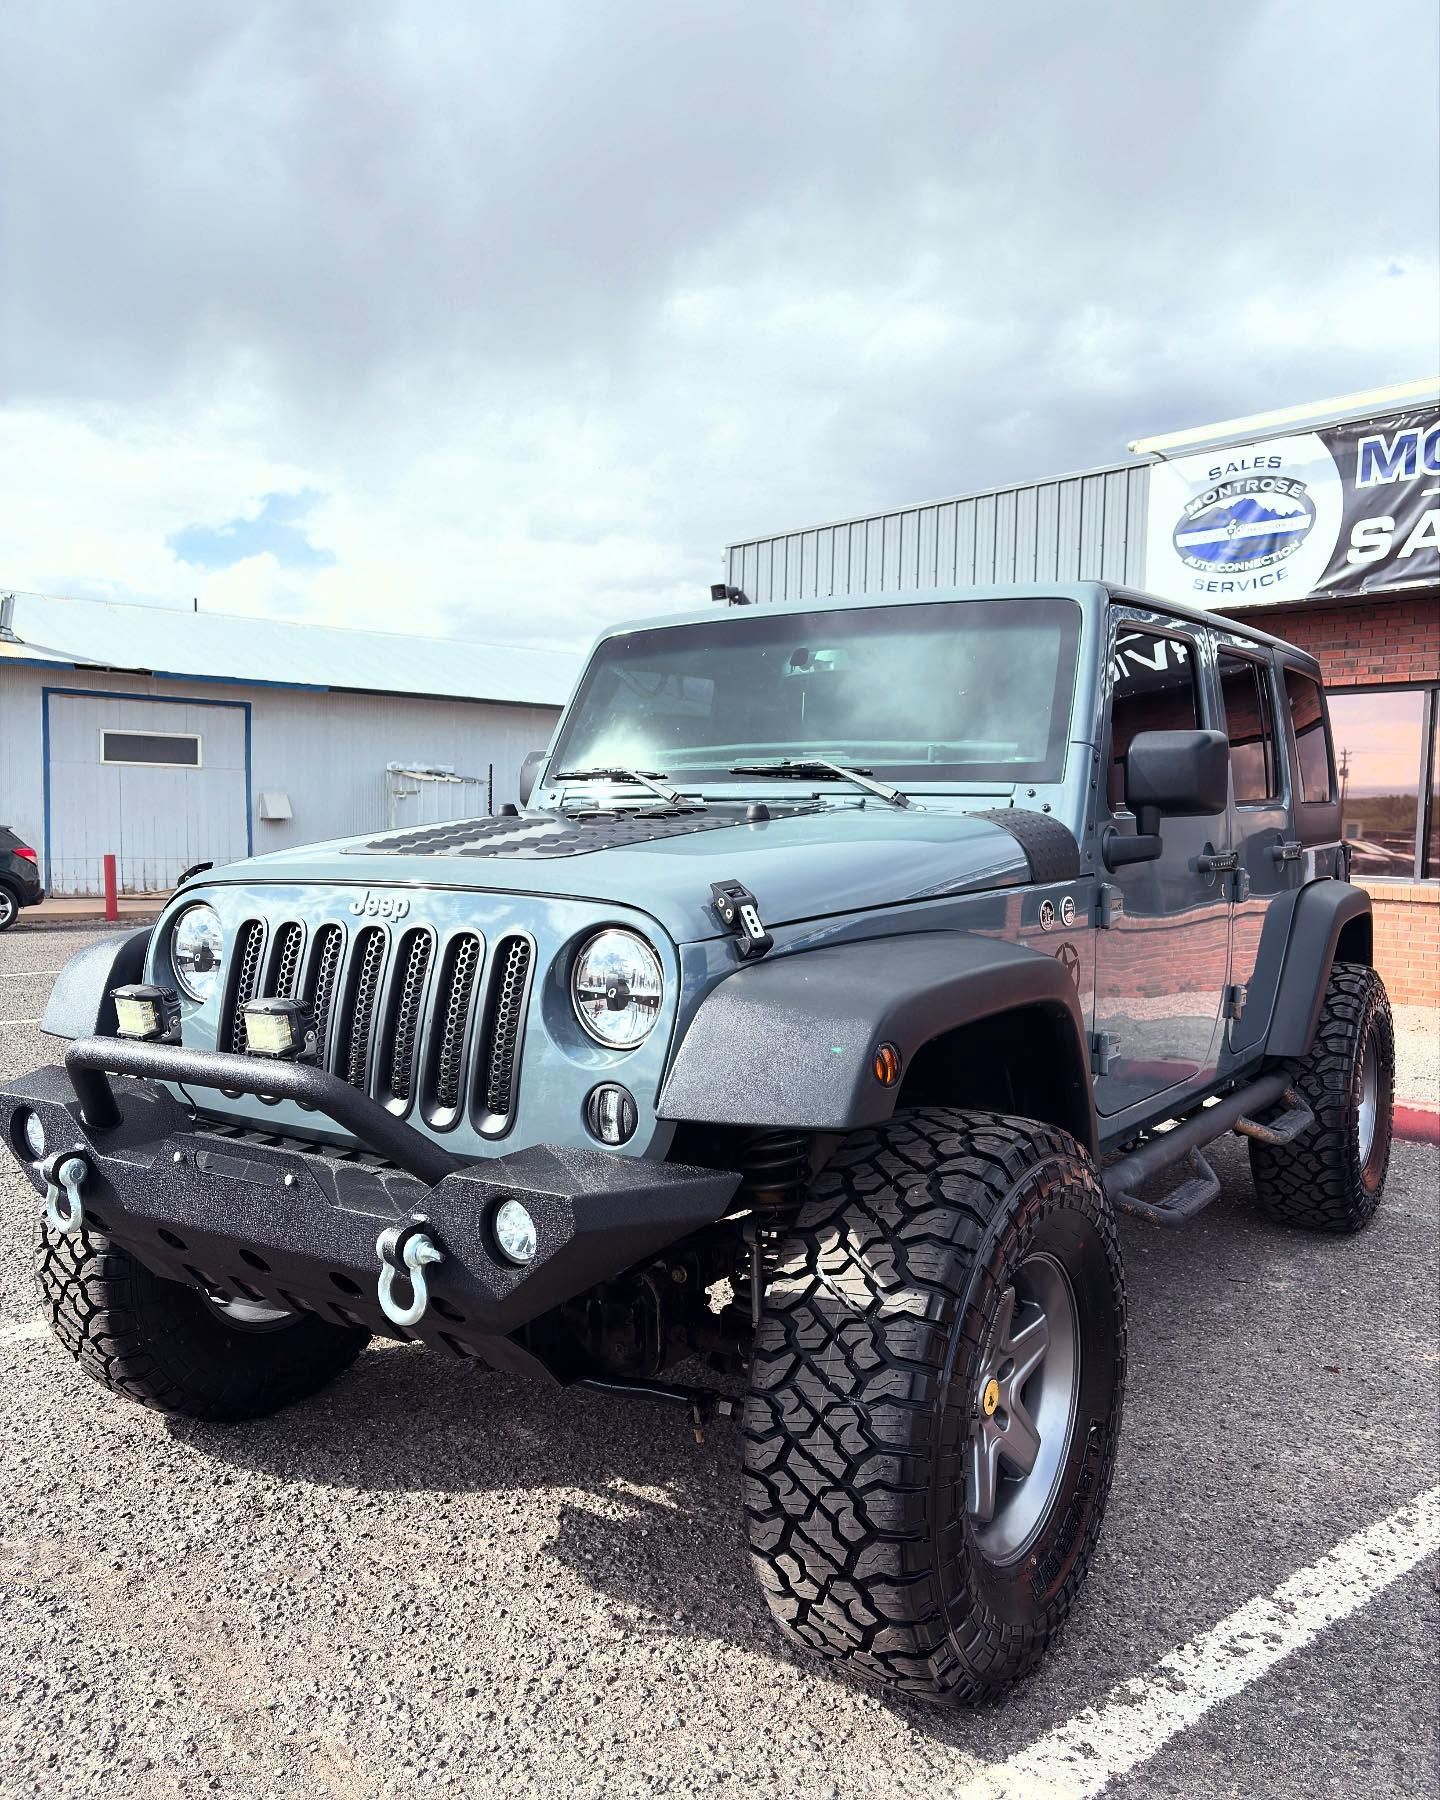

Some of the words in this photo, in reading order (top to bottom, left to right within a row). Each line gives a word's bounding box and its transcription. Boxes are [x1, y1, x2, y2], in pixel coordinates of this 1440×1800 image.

[1208, 456, 1282, 480] SALES
[1185, 478, 1304, 515] MONTROSE
[1184, 555, 1216, 572] AUTO
[1217, 540, 1302, 573] CONNECTION
[1193, 567, 1289, 592] SERVICE
[348, 891, 411, 923] Jeep
